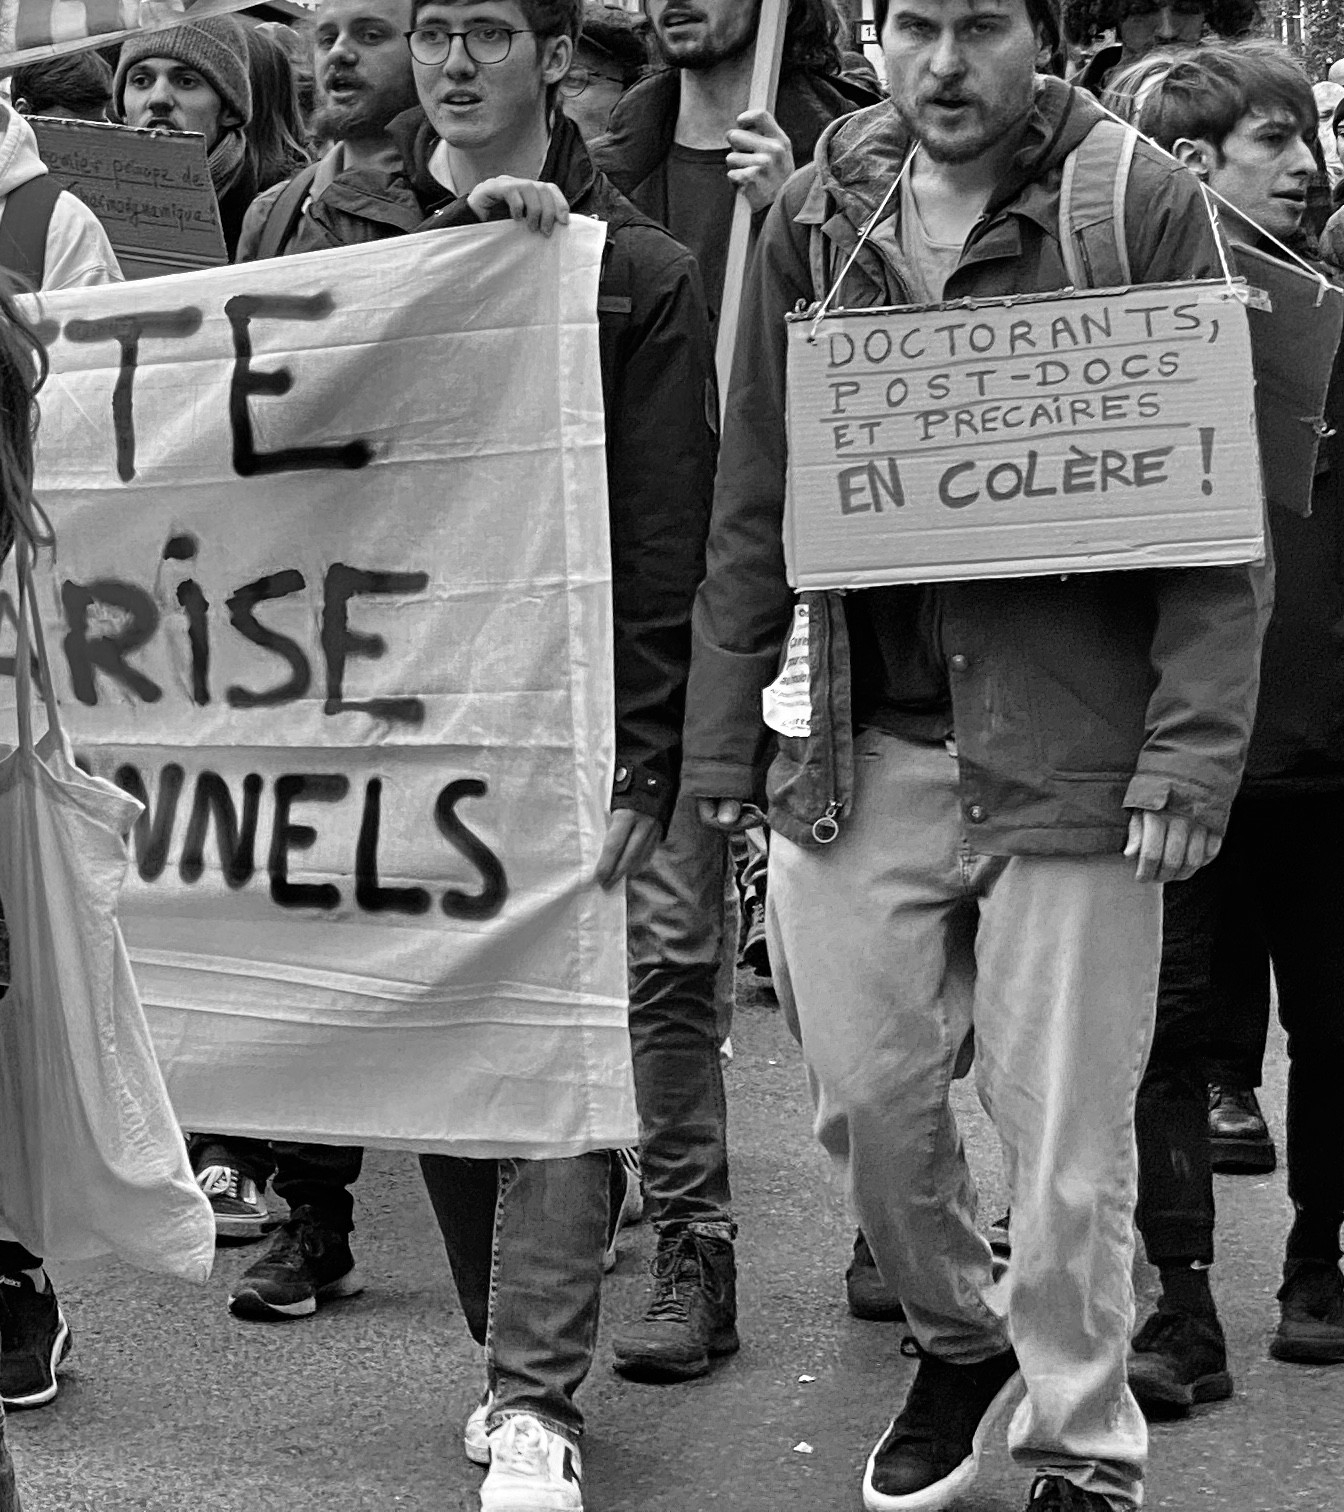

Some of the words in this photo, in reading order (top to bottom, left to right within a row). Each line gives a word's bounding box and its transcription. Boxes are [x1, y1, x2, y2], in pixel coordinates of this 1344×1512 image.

[827, 303, 1221, 369] DOCTORANTS,
[831, 351, 1181, 416] POST-DOCS
[833, 420, 883, 450] ET
[837, 456, 906, 516] EN
[938, 444, 1176, 510] COLÈRE
